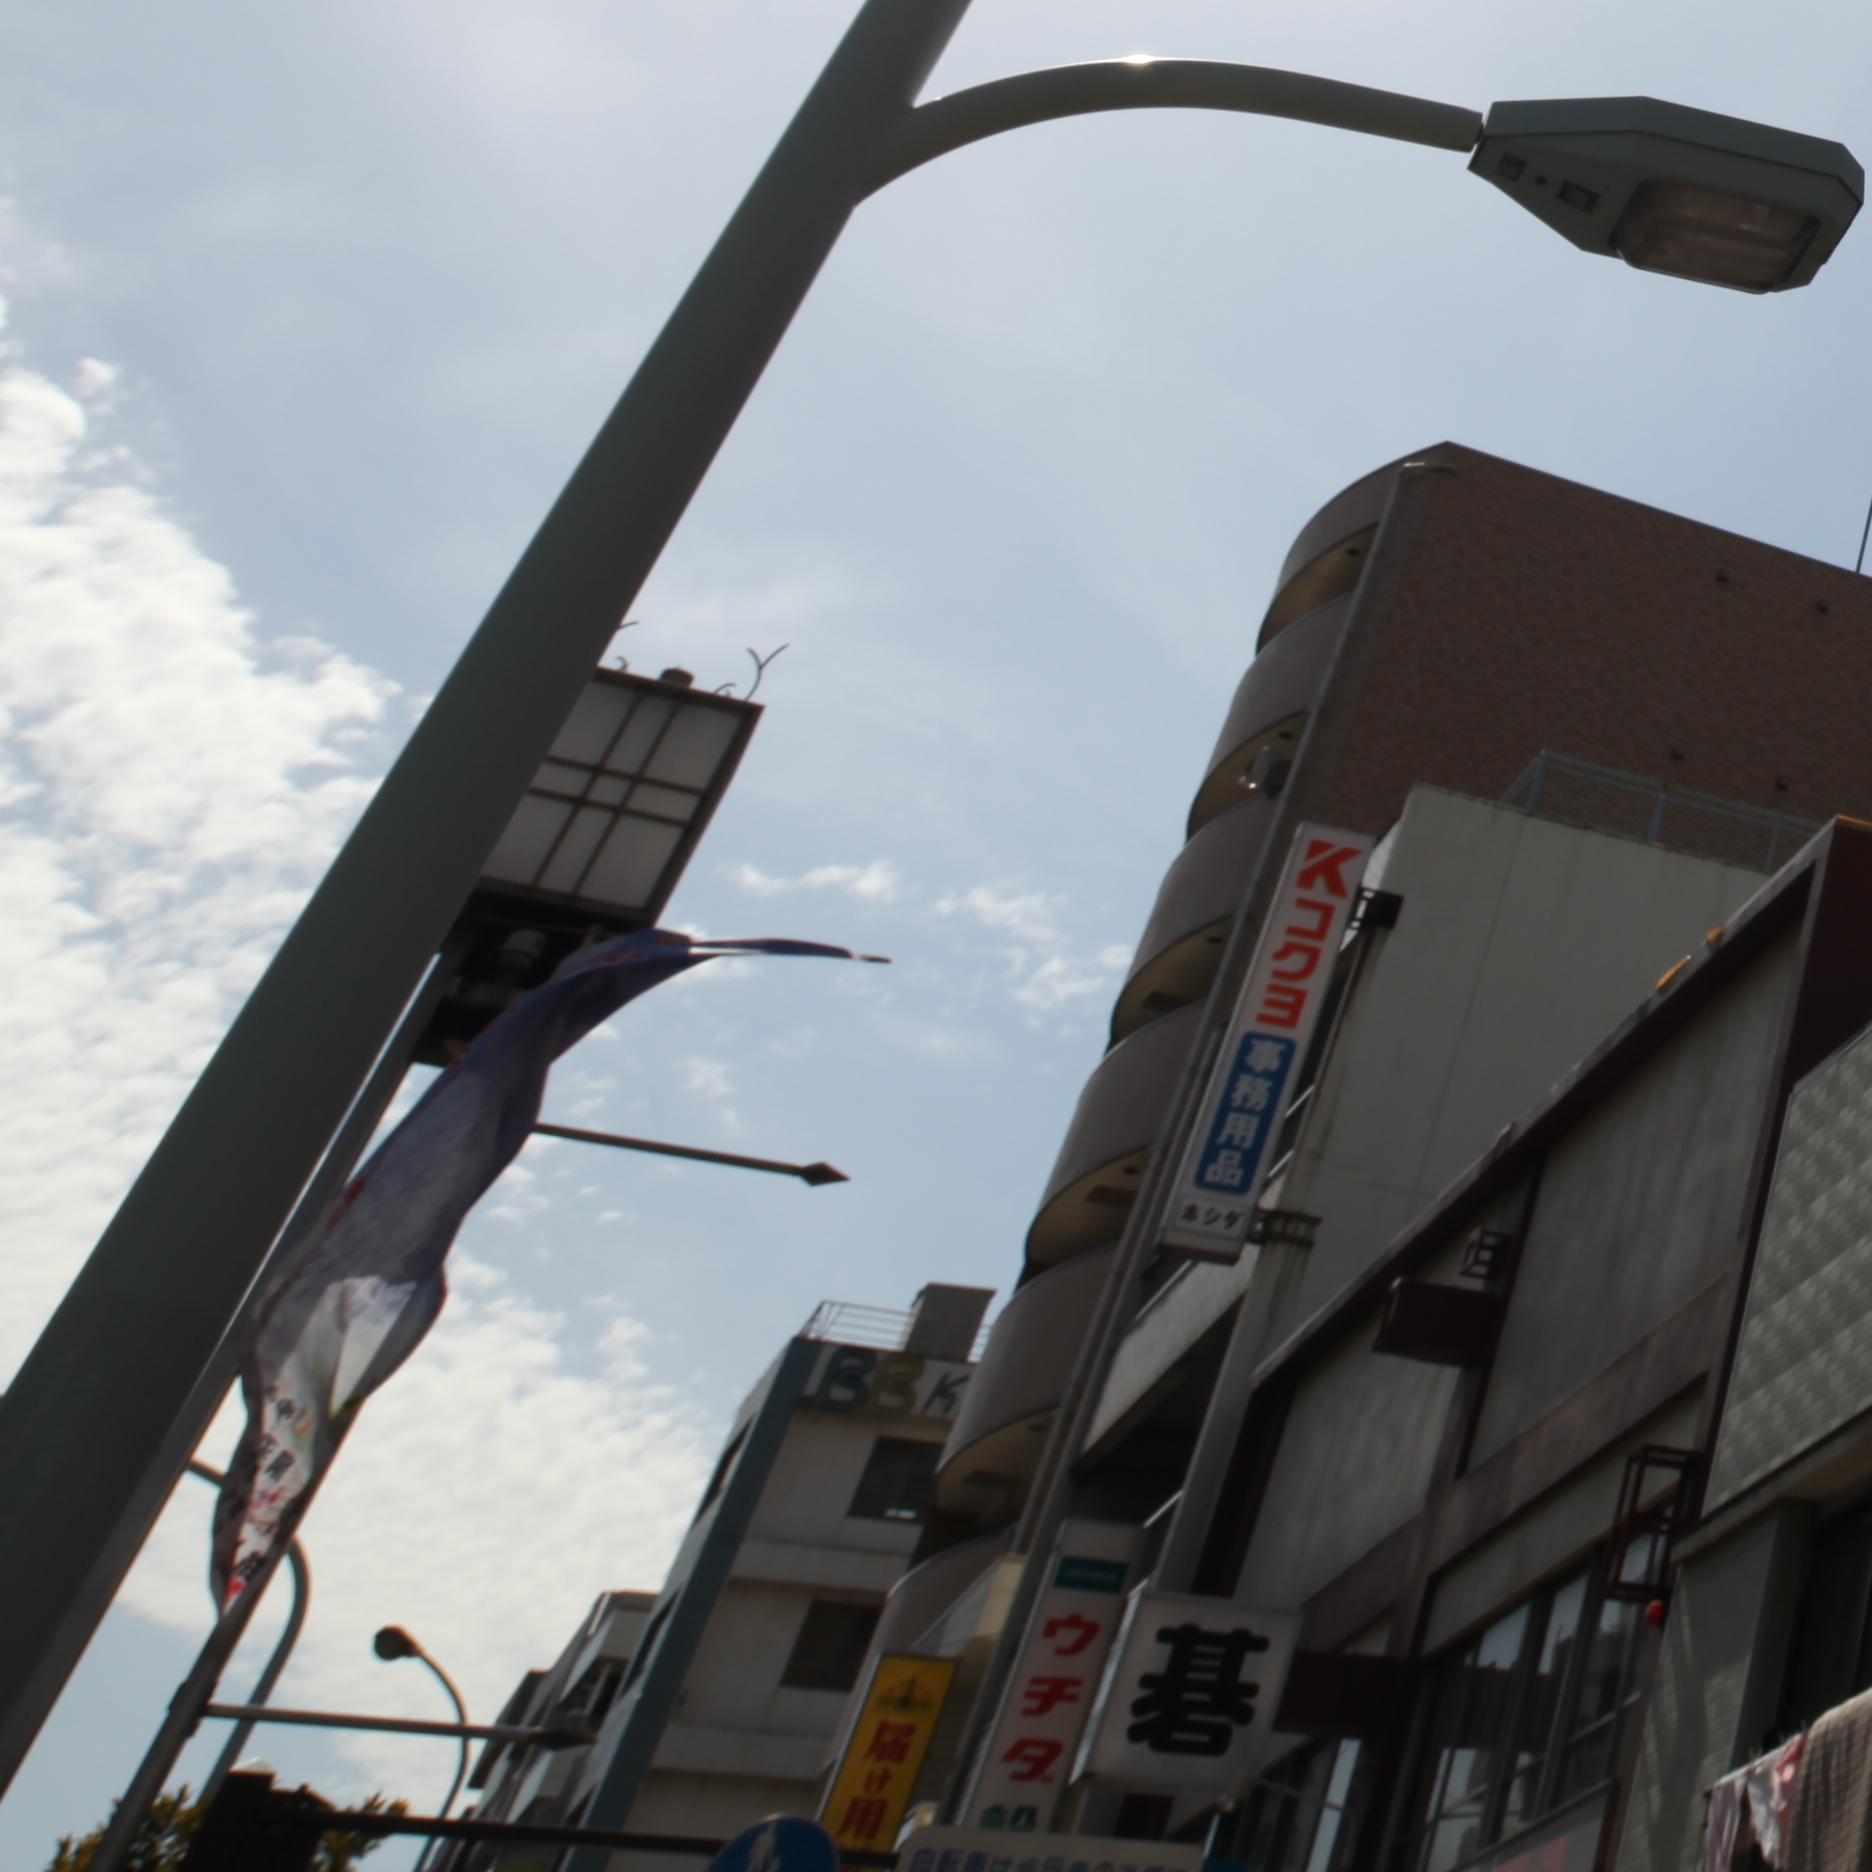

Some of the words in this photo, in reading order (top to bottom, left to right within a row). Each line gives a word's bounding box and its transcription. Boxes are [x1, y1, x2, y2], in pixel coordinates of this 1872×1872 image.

[1203, 1038, 1287, 1187] 事務用品
[1127, 1623, 1270, 1757] 碁
